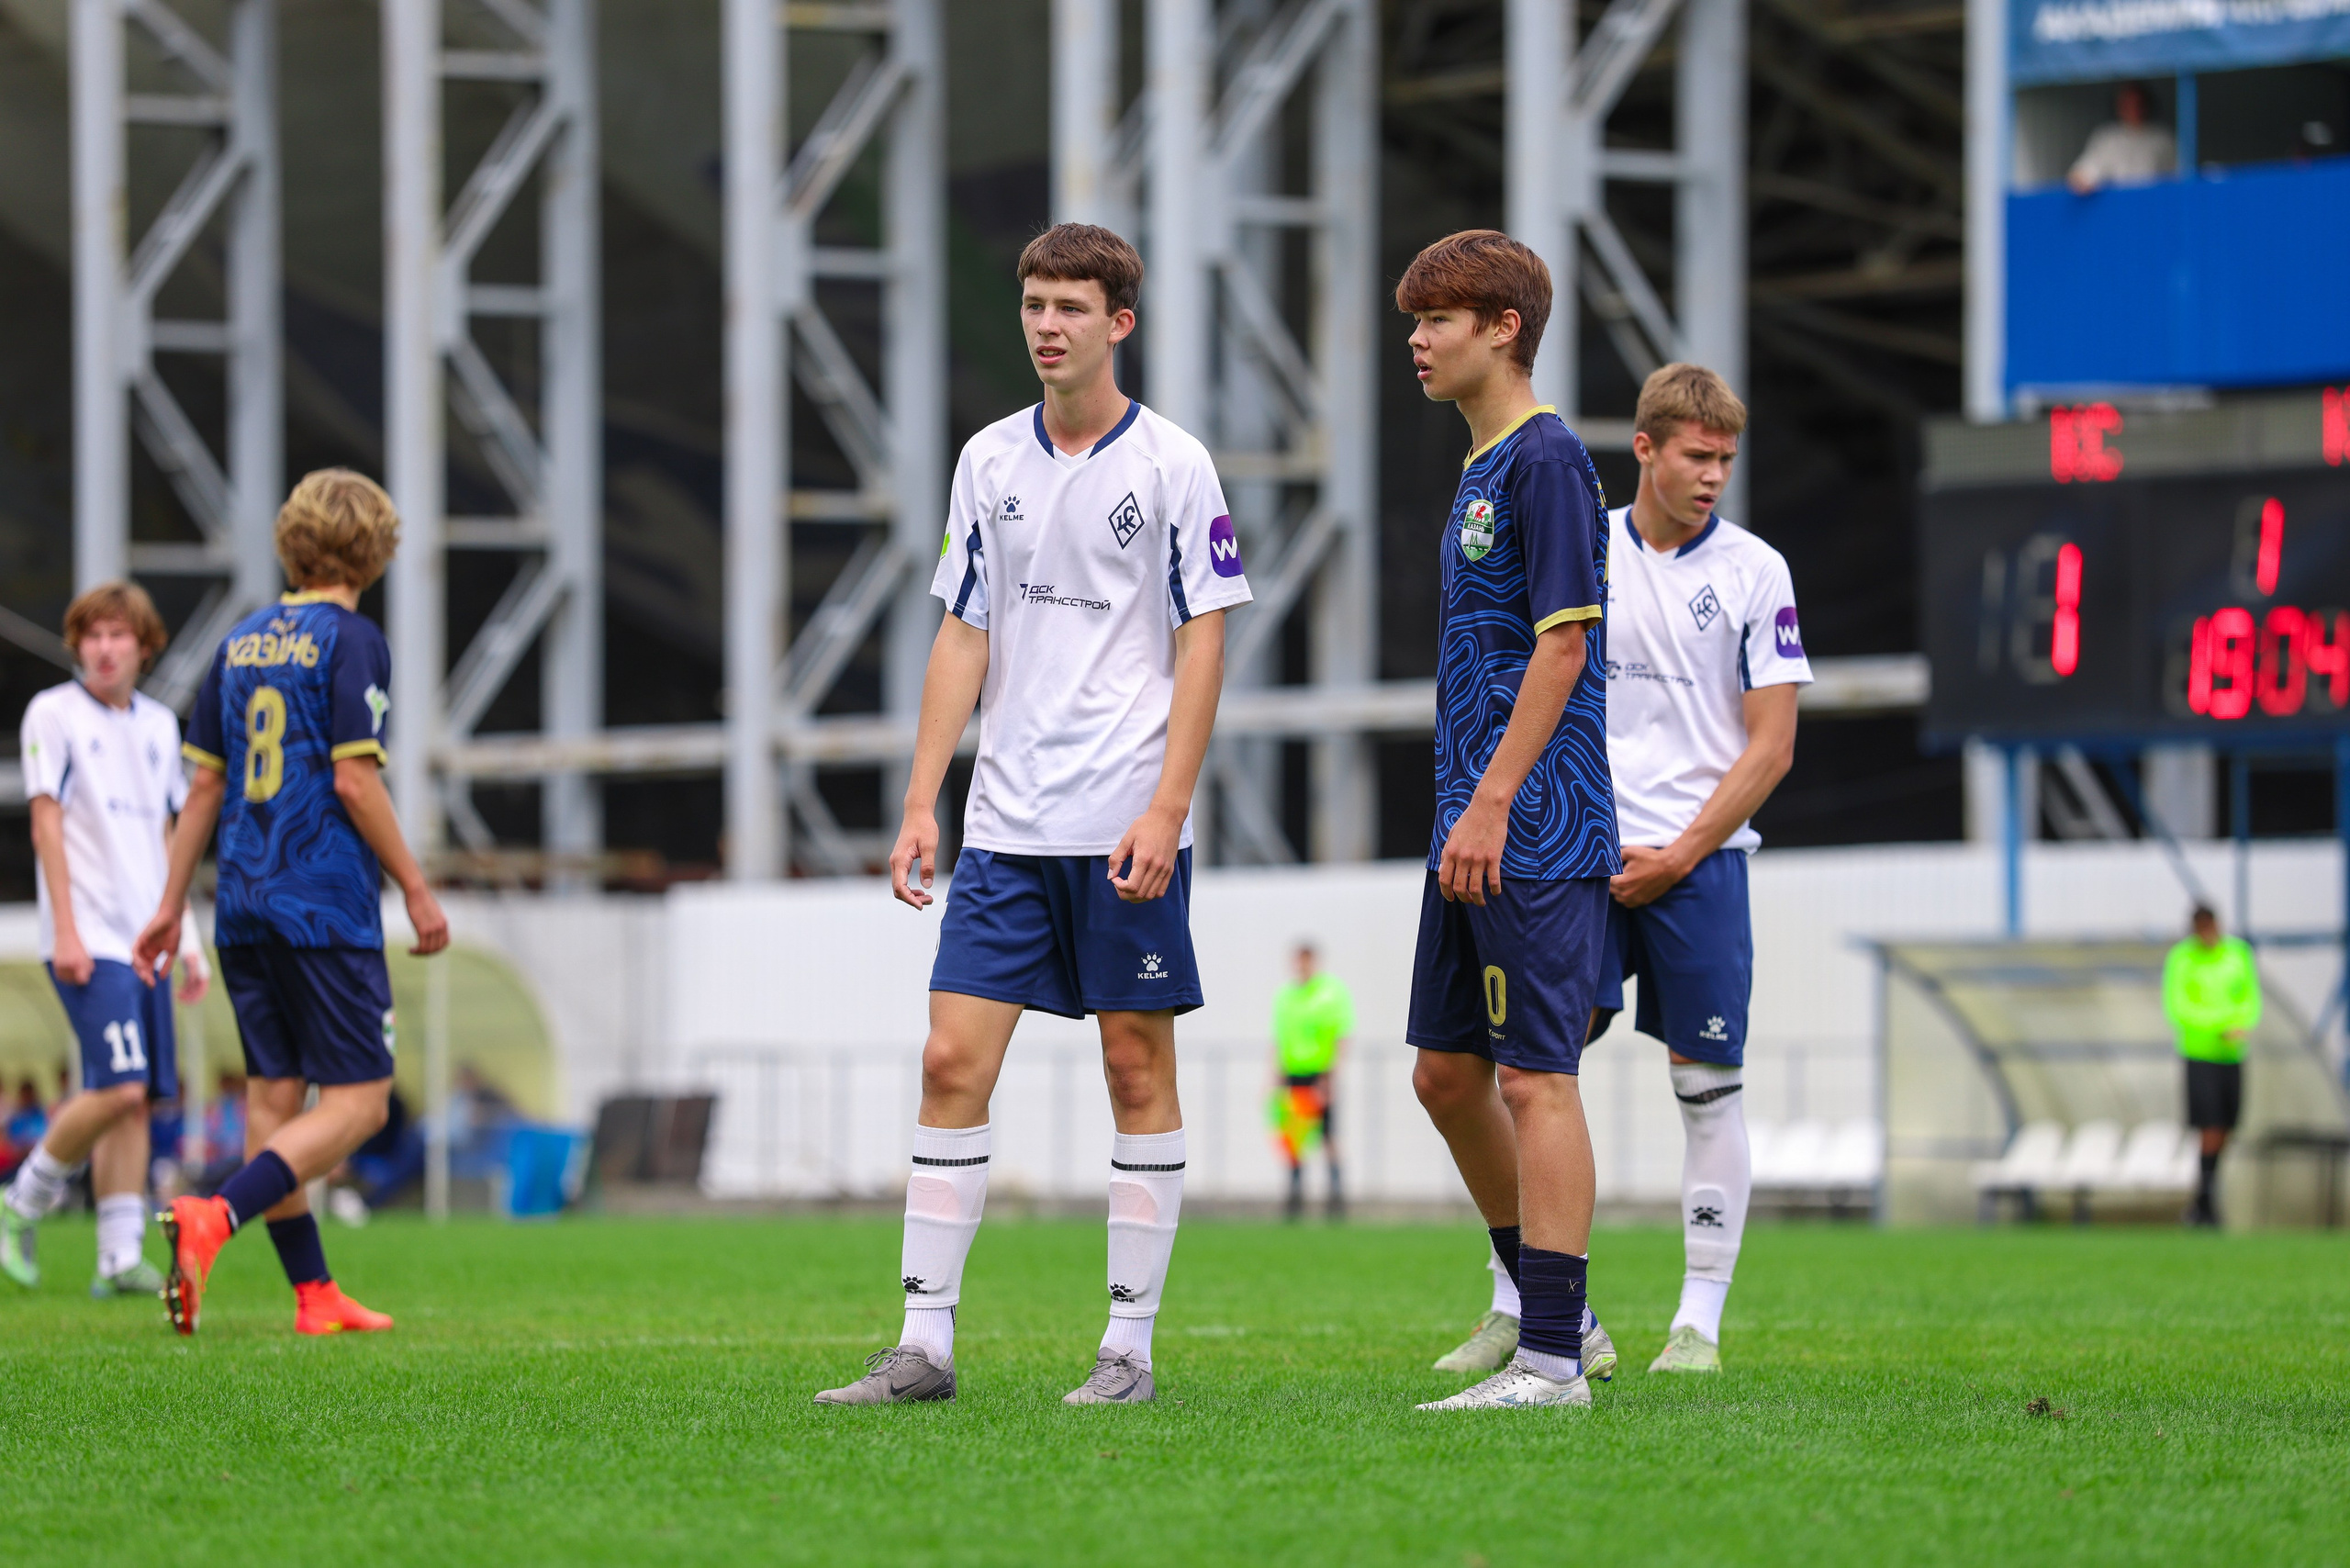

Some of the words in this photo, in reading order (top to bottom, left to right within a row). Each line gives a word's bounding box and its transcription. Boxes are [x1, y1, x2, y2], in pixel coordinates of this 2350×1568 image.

[1029, 586, 1055, 594] ДСК
[1028, 595, 1111, 610] ТРАНССТРОЙ
[243, 685, 286, 803] 8
[1137, 971, 1169, 980] KELME
[103, 1019, 148, 1073] 11
